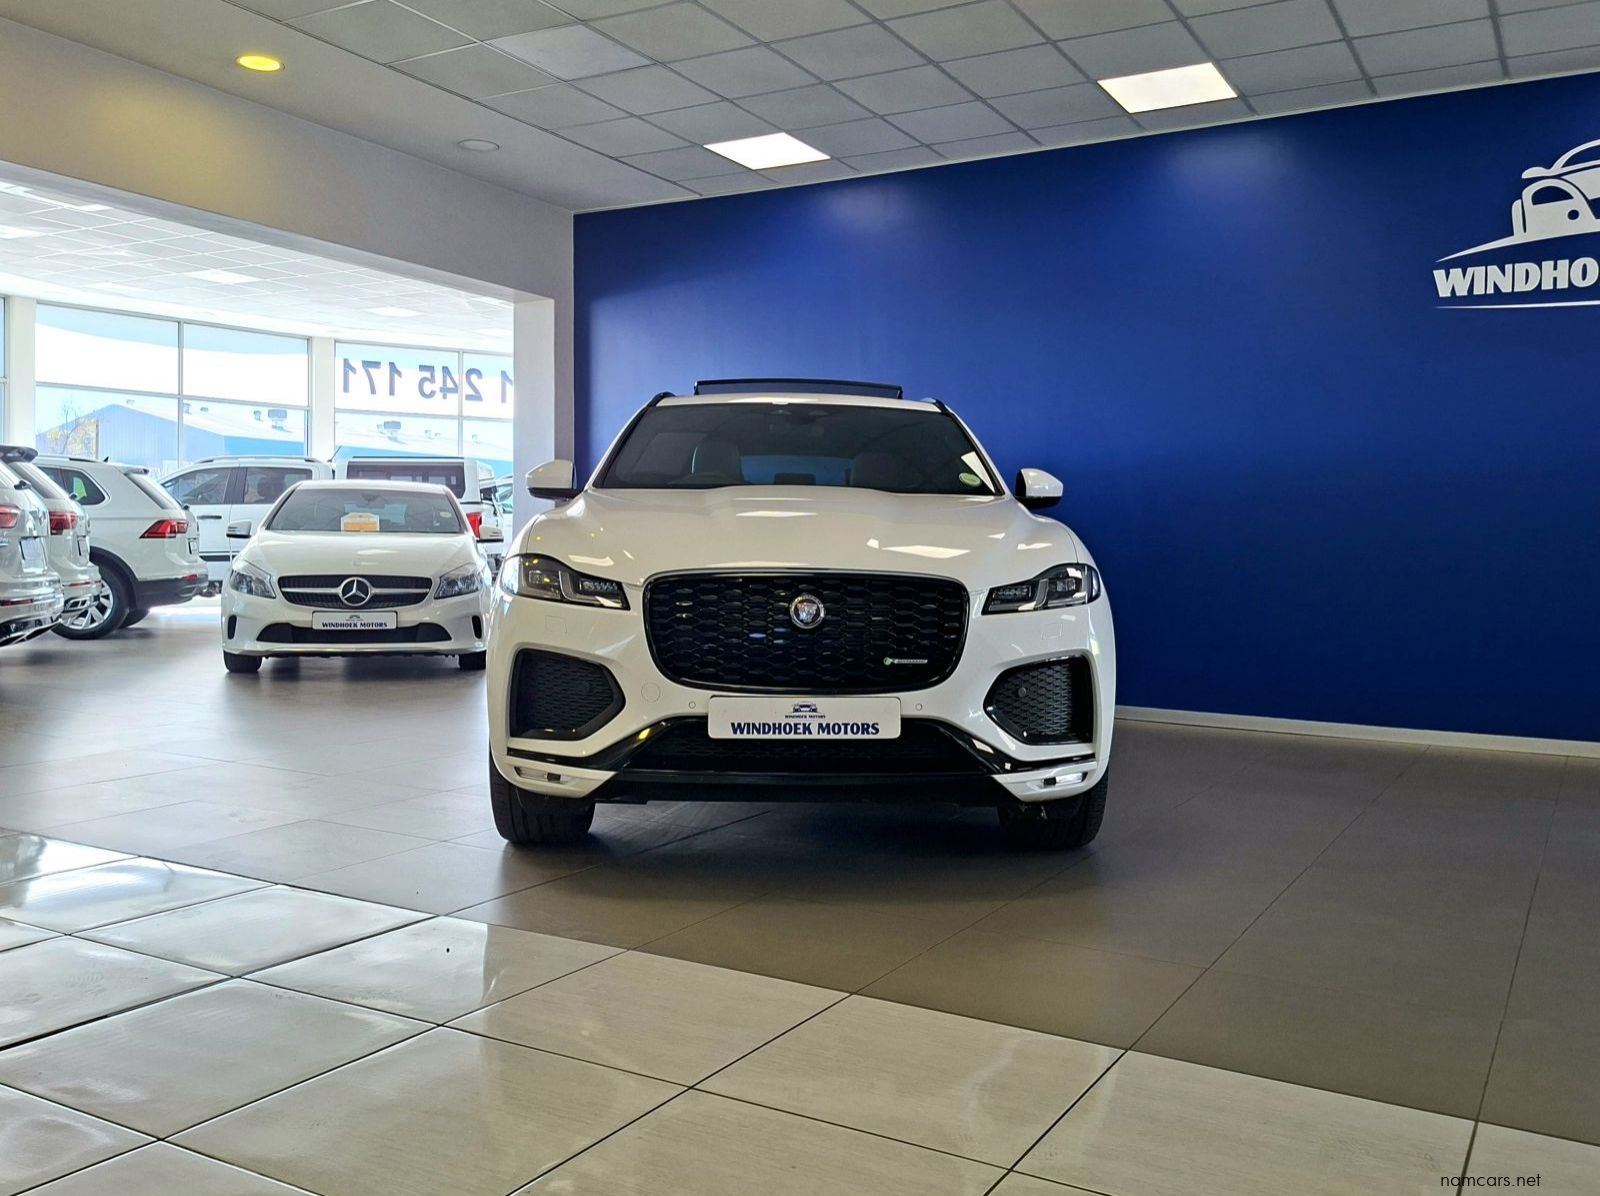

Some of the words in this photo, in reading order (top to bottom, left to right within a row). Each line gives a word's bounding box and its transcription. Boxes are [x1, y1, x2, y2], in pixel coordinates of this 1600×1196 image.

[1433, 257, 1600, 298] WINDHO
[322, 621, 358, 629] WINDHOEK
[730, 722, 813, 735] WINDHOEK
[817, 722, 880, 735] MOTORS
